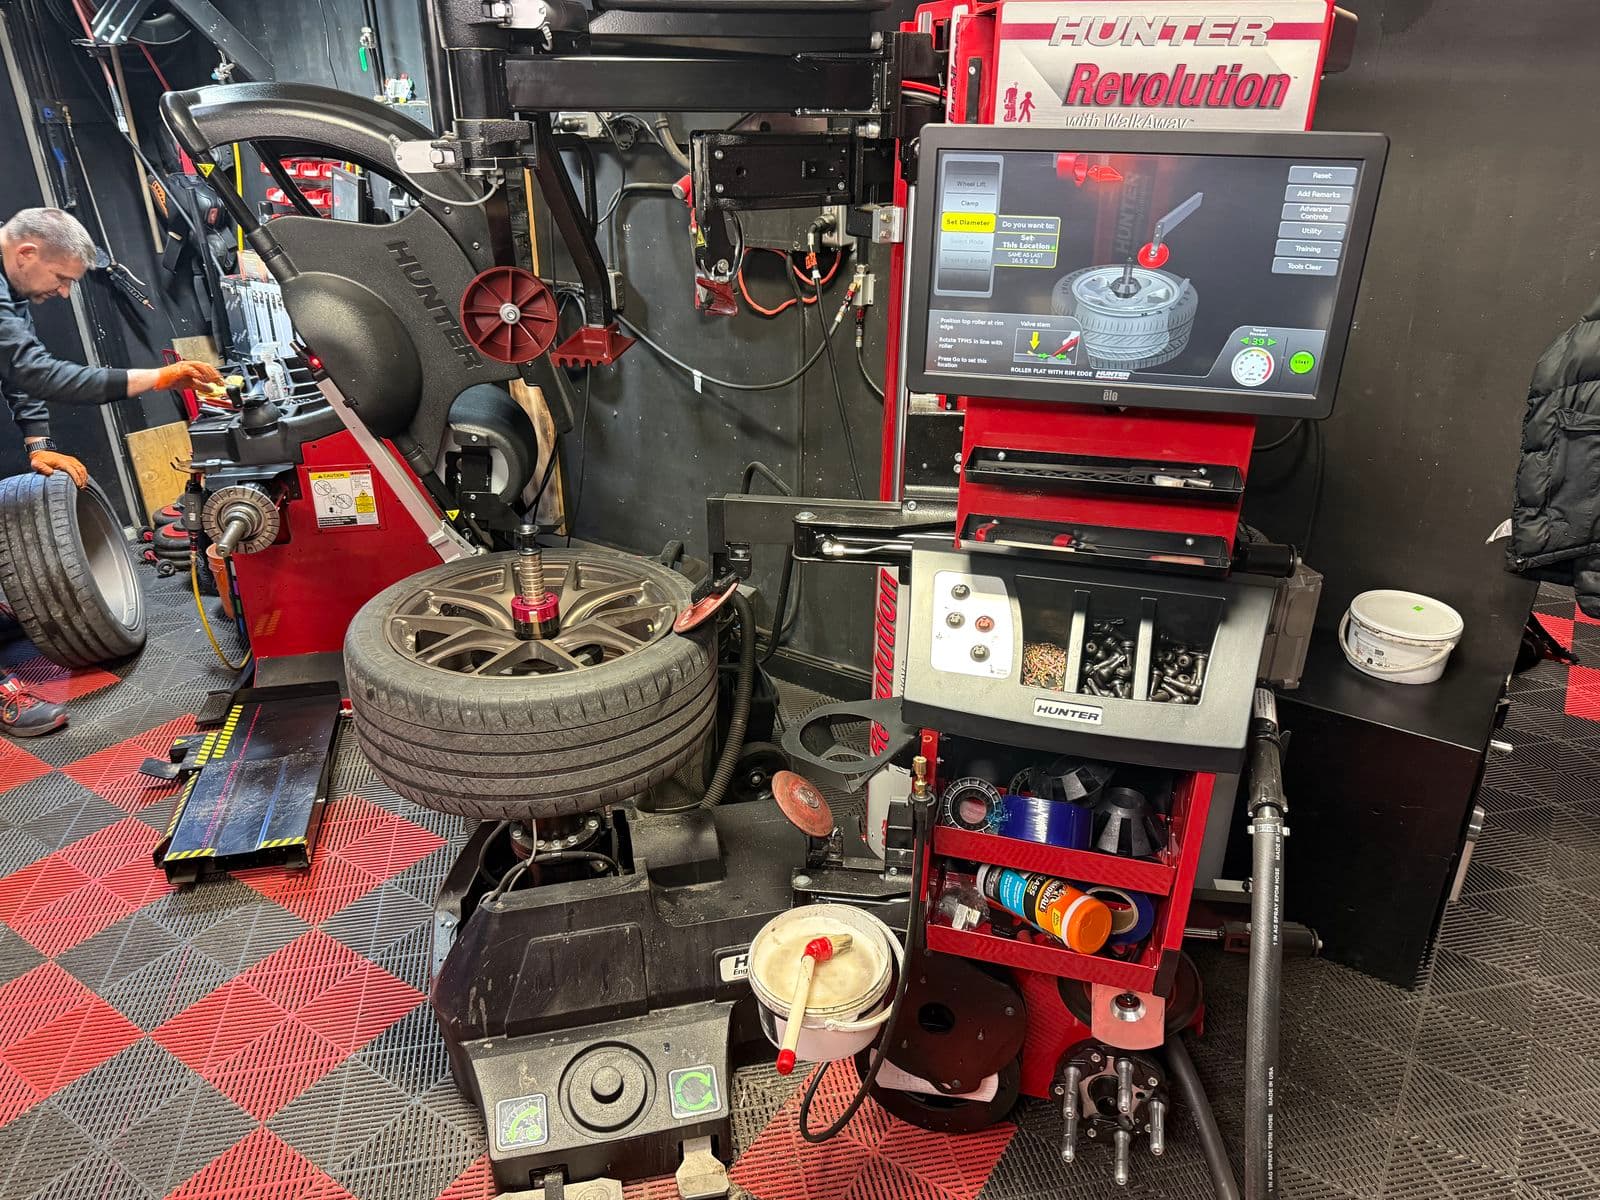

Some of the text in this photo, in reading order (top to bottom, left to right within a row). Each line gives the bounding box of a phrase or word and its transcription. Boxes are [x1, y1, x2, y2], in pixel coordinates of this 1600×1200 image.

[1049, 16, 1274, 46] HUNTER
[1066, 63, 1291, 107] Revolution
[1066, 112, 1100, 127] with
[957, 180, 976, 188] Wheel
[1013, 222, 1026, 230] you
[1302, 228, 1322, 236] Utility
[1020, 242, 1051, 250] Location
[1296, 246, 1321, 254] Training
[1288, 262, 1304, 270] Tools
[386, 240, 485, 371] HUNTER
[1252, 338, 1264, 346] 39
[1076, 370, 1093, 378] EDGE
[1095, 370, 1131, 380] HUNTER
[870, 567, 899, 757] Reolution
[1036, 705, 1100, 721] HUNTER
